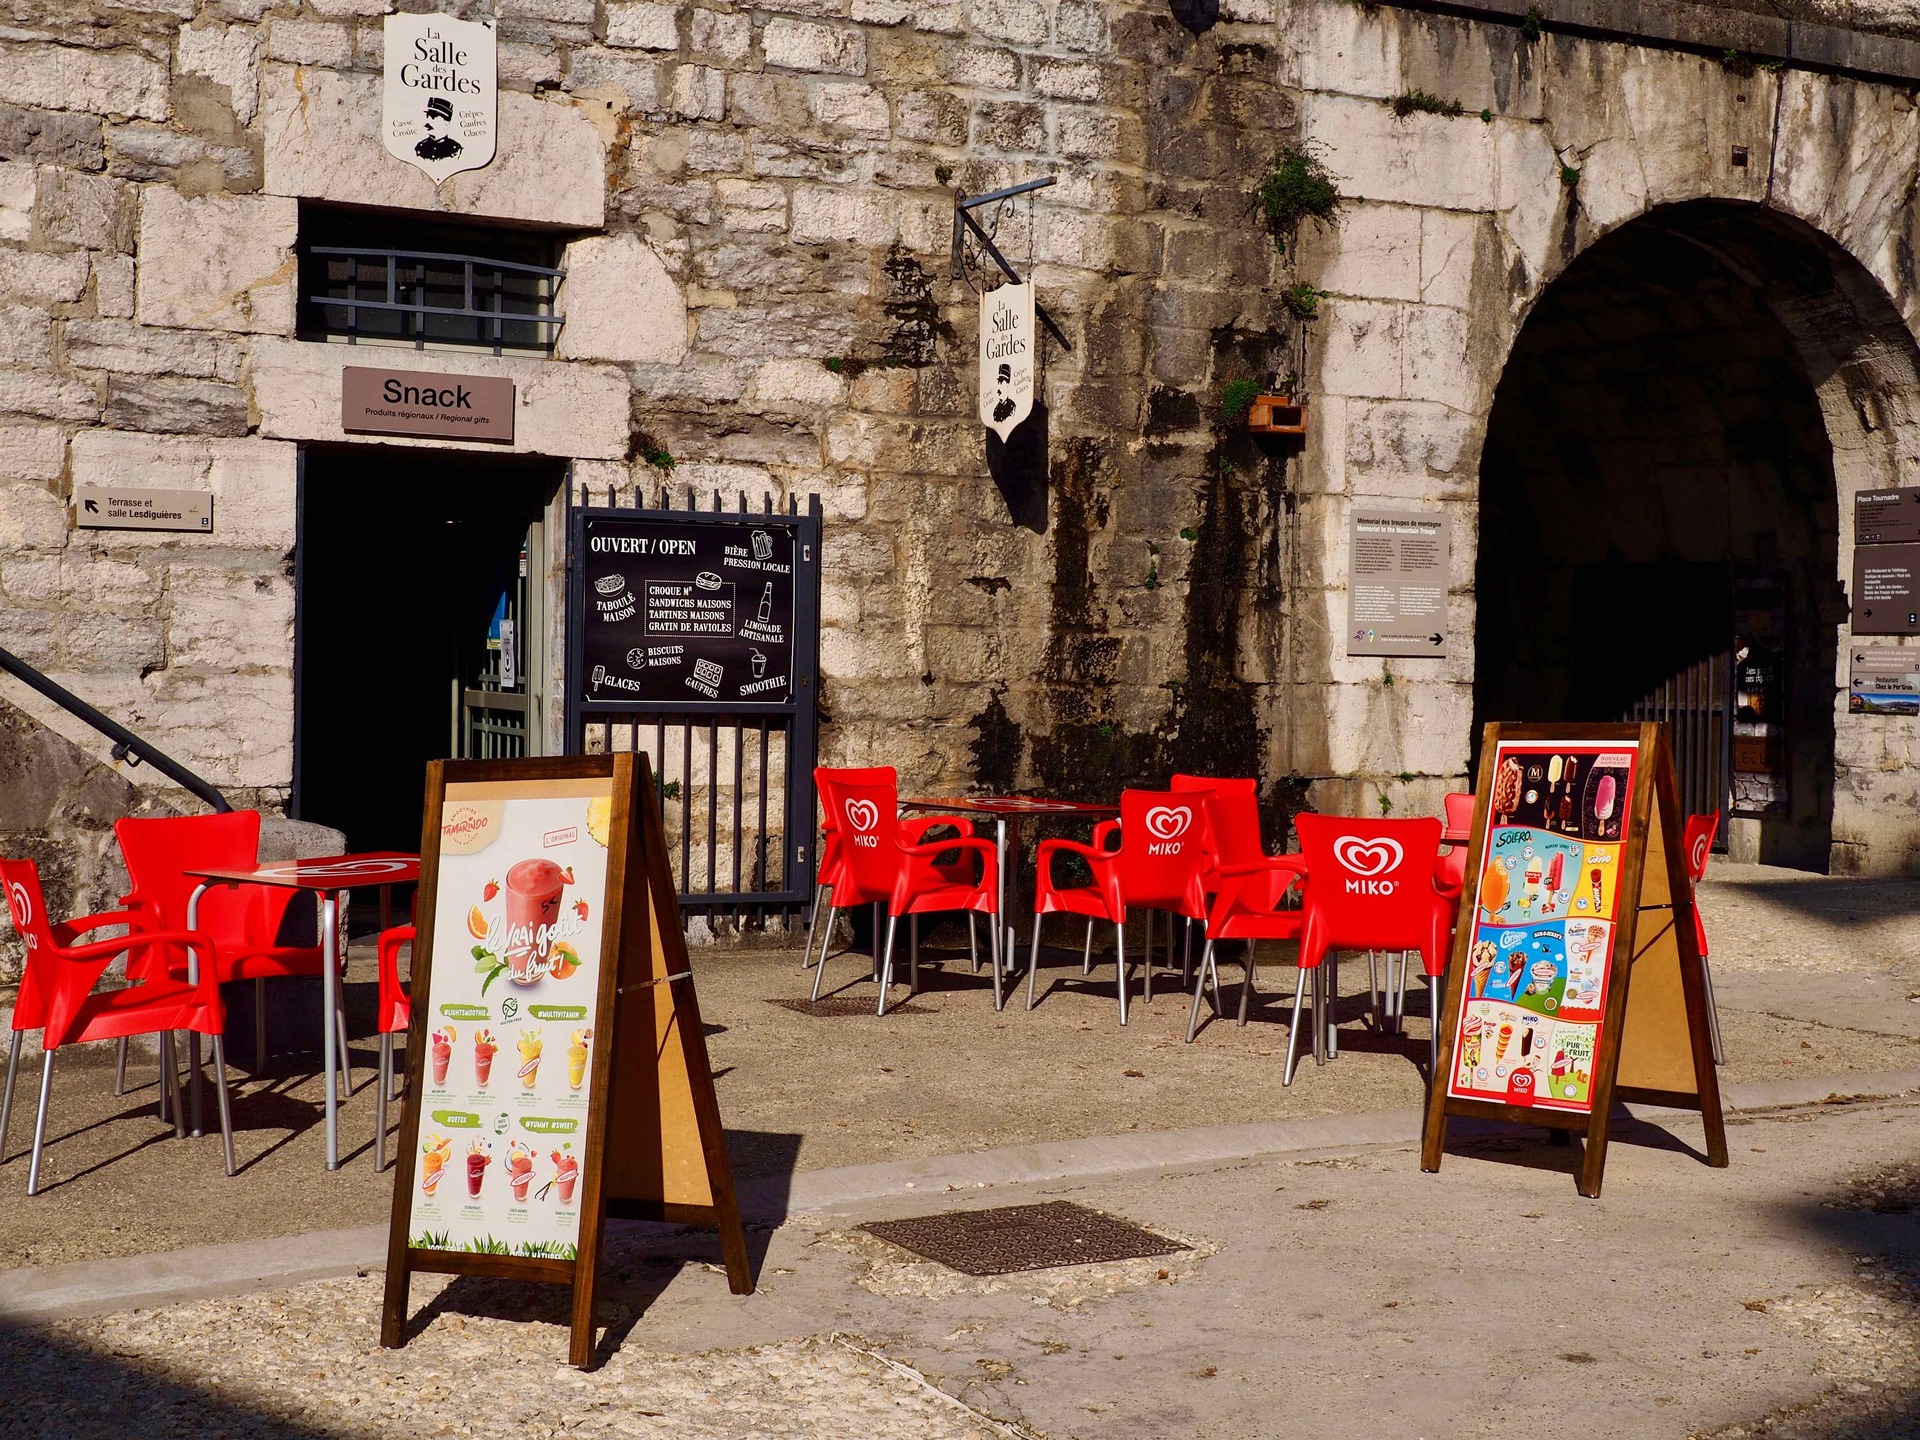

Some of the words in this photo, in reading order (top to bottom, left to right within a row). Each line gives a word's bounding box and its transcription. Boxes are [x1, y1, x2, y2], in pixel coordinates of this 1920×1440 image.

[427, 27, 440, 39] La
[414, 38, 467, 66] Salle
[432, 64, 447, 73] des
[400, 63, 481, 95] Gardes
[458, 110, 484, 120] Crêpes
[392, 119, 413, 128] Casse
[459, 119, 487, 129] Gaufres
[392, 128, 418, 138] Croûte
[463, 129, 487, 138] Glaces
[998, 300, 1006, 310] La
[992, 309, 1019, 334] Salle
[1000, 332, 1009, 342] des
[986, 334, 1026, 360] Gardes
[383, 378, 472, 409] Snack
[365, 408, 396, 417] Produits
[397, 410, 434, 420] régionaux
[440, 414, 473, 423] Regional
[473, 416, 490, 424] gifts
[107, 497, 142, 508] Terrasse
[144, 499, 153, 508] et
[1873, 494, 1899, 502] Tournadre
[107, 509, 127, 518] salle
[129, 509, 182, 521] Lesdiguières
[1357, 517, 1380, 525] Mémorial
[1391, 520, 1409, 528] troupes
[1417, 521, 1442, 529] montagne
[1356, 525, 1380, 533] Memorial
[1396, 526, 1419, 535] Mountain
[1420, 527, 1437, 536] Troops
[591, 537, 648, 554] OUVERT
[651, 538, 656, 555] /
[659, 539, 696, 555] OPEN
[724, 544, 748, 557] BIÈRE
[723, 557, 761, 570] PRESSION
[762, 561, 791, 574] LOCALE
[649, 586, 681, 596] CROQUE
[596, 591, 636, 611] TABOULÉ
[649, 598, 695, 608] SANDWICHS
[696, 599, 732, 609] MAISONS
[602, 605, 636, 622] MAISON
[649, 610, 688, 620] TARTINES
[689, 611, 725, 621] MAISONS
[649, 622, 678, 632] GRATIN
[680, 622, 692, 632] DE
[693, 623, 732, 633] RAVIOLES
[744, 619, 782, 633] LIMONADE
[738, 628, 784, 643] ARTISANALE
[648, 645, 684, 656] BISCUITS
[648, 656, 682, 667] MAISONS
[604, 675, 641, 691] GLACES
[685, 676, 719, 699] GAUFRES
[739, 675, 787, 696] SMOOTHIE
[442, 817, 488, 836] TAMARINDO
[854, 834, 878, 848] MIKO
[1148, 842, 1181, 856] MIKO
[1345, 878, 1394, 896] MIKO
[507, 963, 525, 981] du
[1522, 1015, 1539, 1023] MIKO
[1566, 1041, 1581, 1049] PUR
[1569, 1049, 1590, 1057] FRUIT
